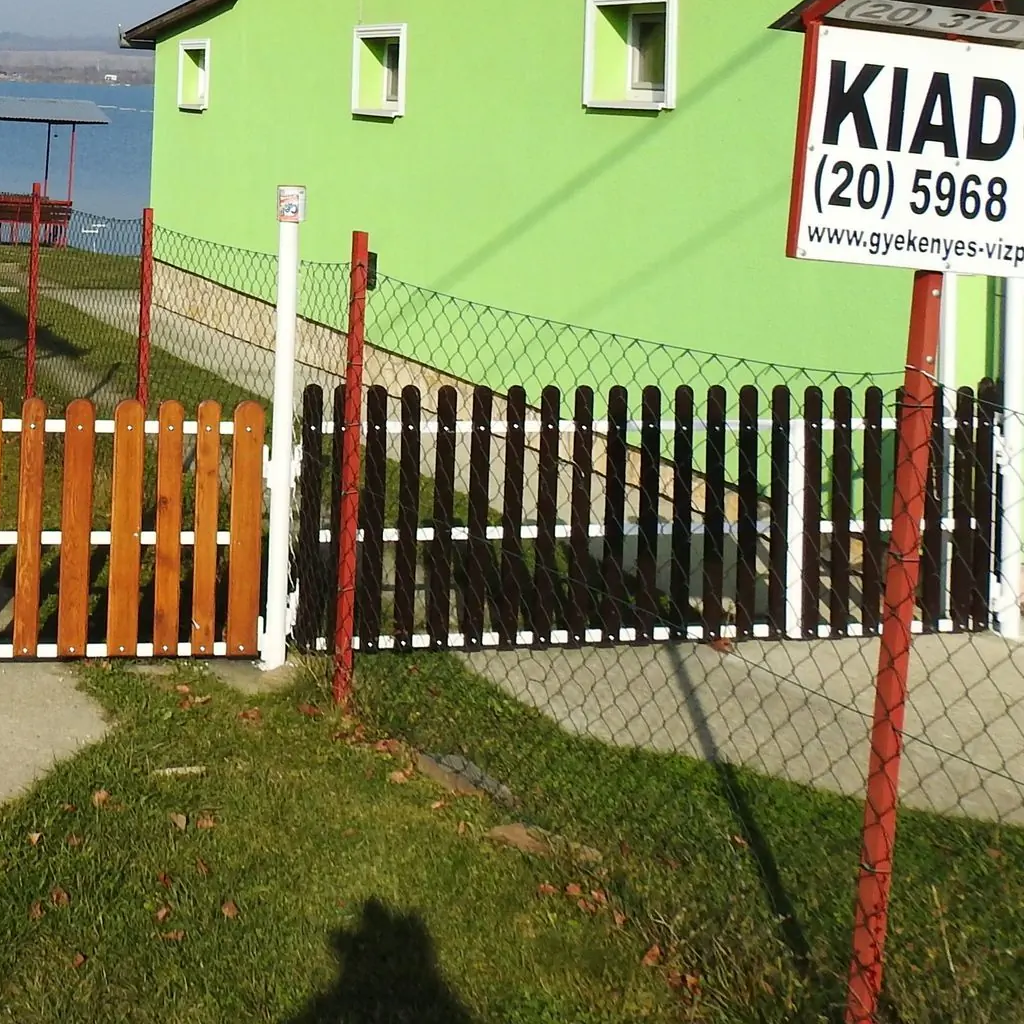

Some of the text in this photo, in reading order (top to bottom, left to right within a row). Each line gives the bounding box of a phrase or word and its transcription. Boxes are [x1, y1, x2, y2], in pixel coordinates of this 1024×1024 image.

[844, 0, 1021, 35] (20) 370
[822, 59, 1024, 162] KIAD
[814, 153, 1008, 222] (20) 5968
[807, 225, 1024, 268] www.gyekenyes-vizp
